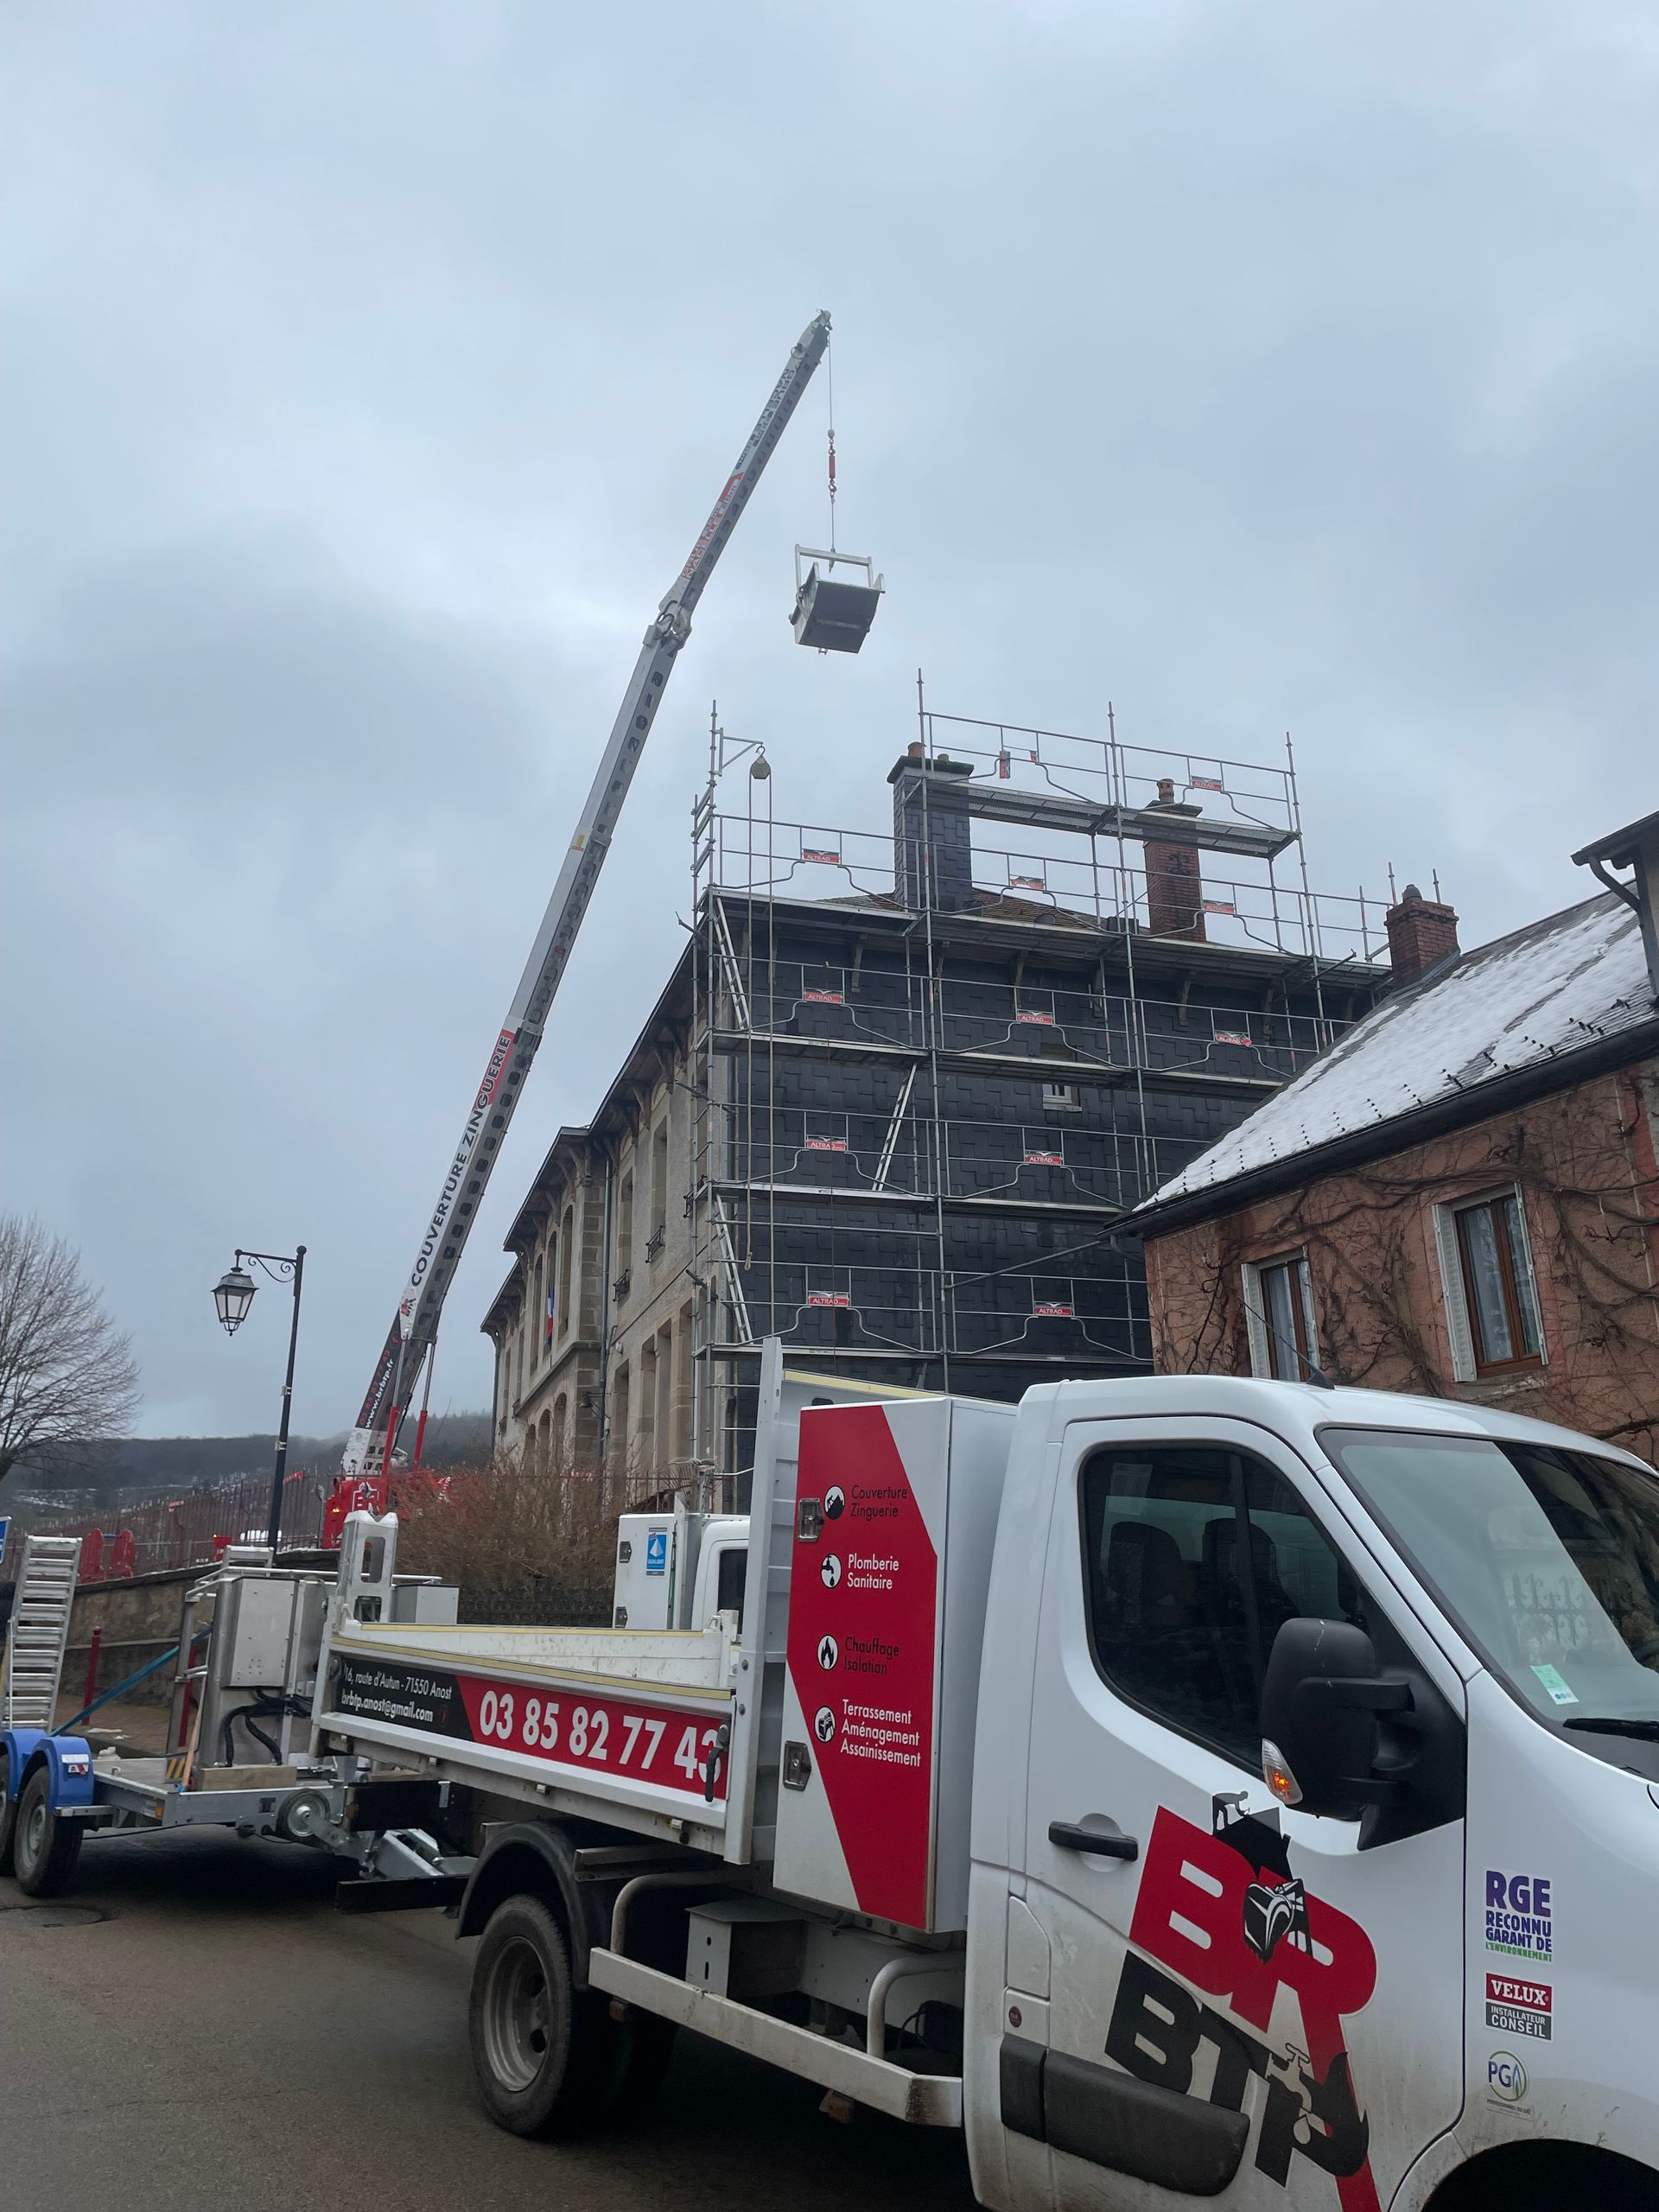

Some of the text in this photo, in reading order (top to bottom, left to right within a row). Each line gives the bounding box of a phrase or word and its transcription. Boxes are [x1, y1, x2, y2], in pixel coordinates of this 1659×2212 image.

[411, 1035, 512, 1287] COUVERTURE ZINGUERIE
[365, 1358, 394, 1428] www.brbtp.fr
[851, 1485, 907, 1499] Couverture
[850, 1503, 899, 1521] Zinguerie
[848, 1553, 899, 1571] Plomberie
[847, 1572, 893, 1589] Sanitaire
[844, 1636, 899, 1660] Chauffage
[844, 1656, 887, 1674] Isolation
[355, 1672, 372, 1686] route
[404, 1676, 429, 1696] 71550
[429, 1681, 453, 1700] Anost
[340, 1688, 434, 1723] brbtp.anost@gmail.com
[842, 1699, 912, 1724] Terrassement
[480, 1690, 514, 1740] 03
[522, 1698, 560, 1750] 85
[569, 1706, 609, 1760] 82
[619, 1715, 667, 1770] 77
[842, 1719, 919, 1746] Aménagement
[841, 1738, 920, 1767] Assainissement
[1486, 1870, 1551, 1917] RGE
[1486, 1910, 1551, 1937] RECONNU
[1485, 1942, 1552, 1962] L'ENVIRONNEMENT
[1486, 1927, 1552, 1953] GARANT DE
[1491, 2005, 1546, 2025] INSTALLATEUR
[1491, 2014, 1546, 2037] CONSEIL
